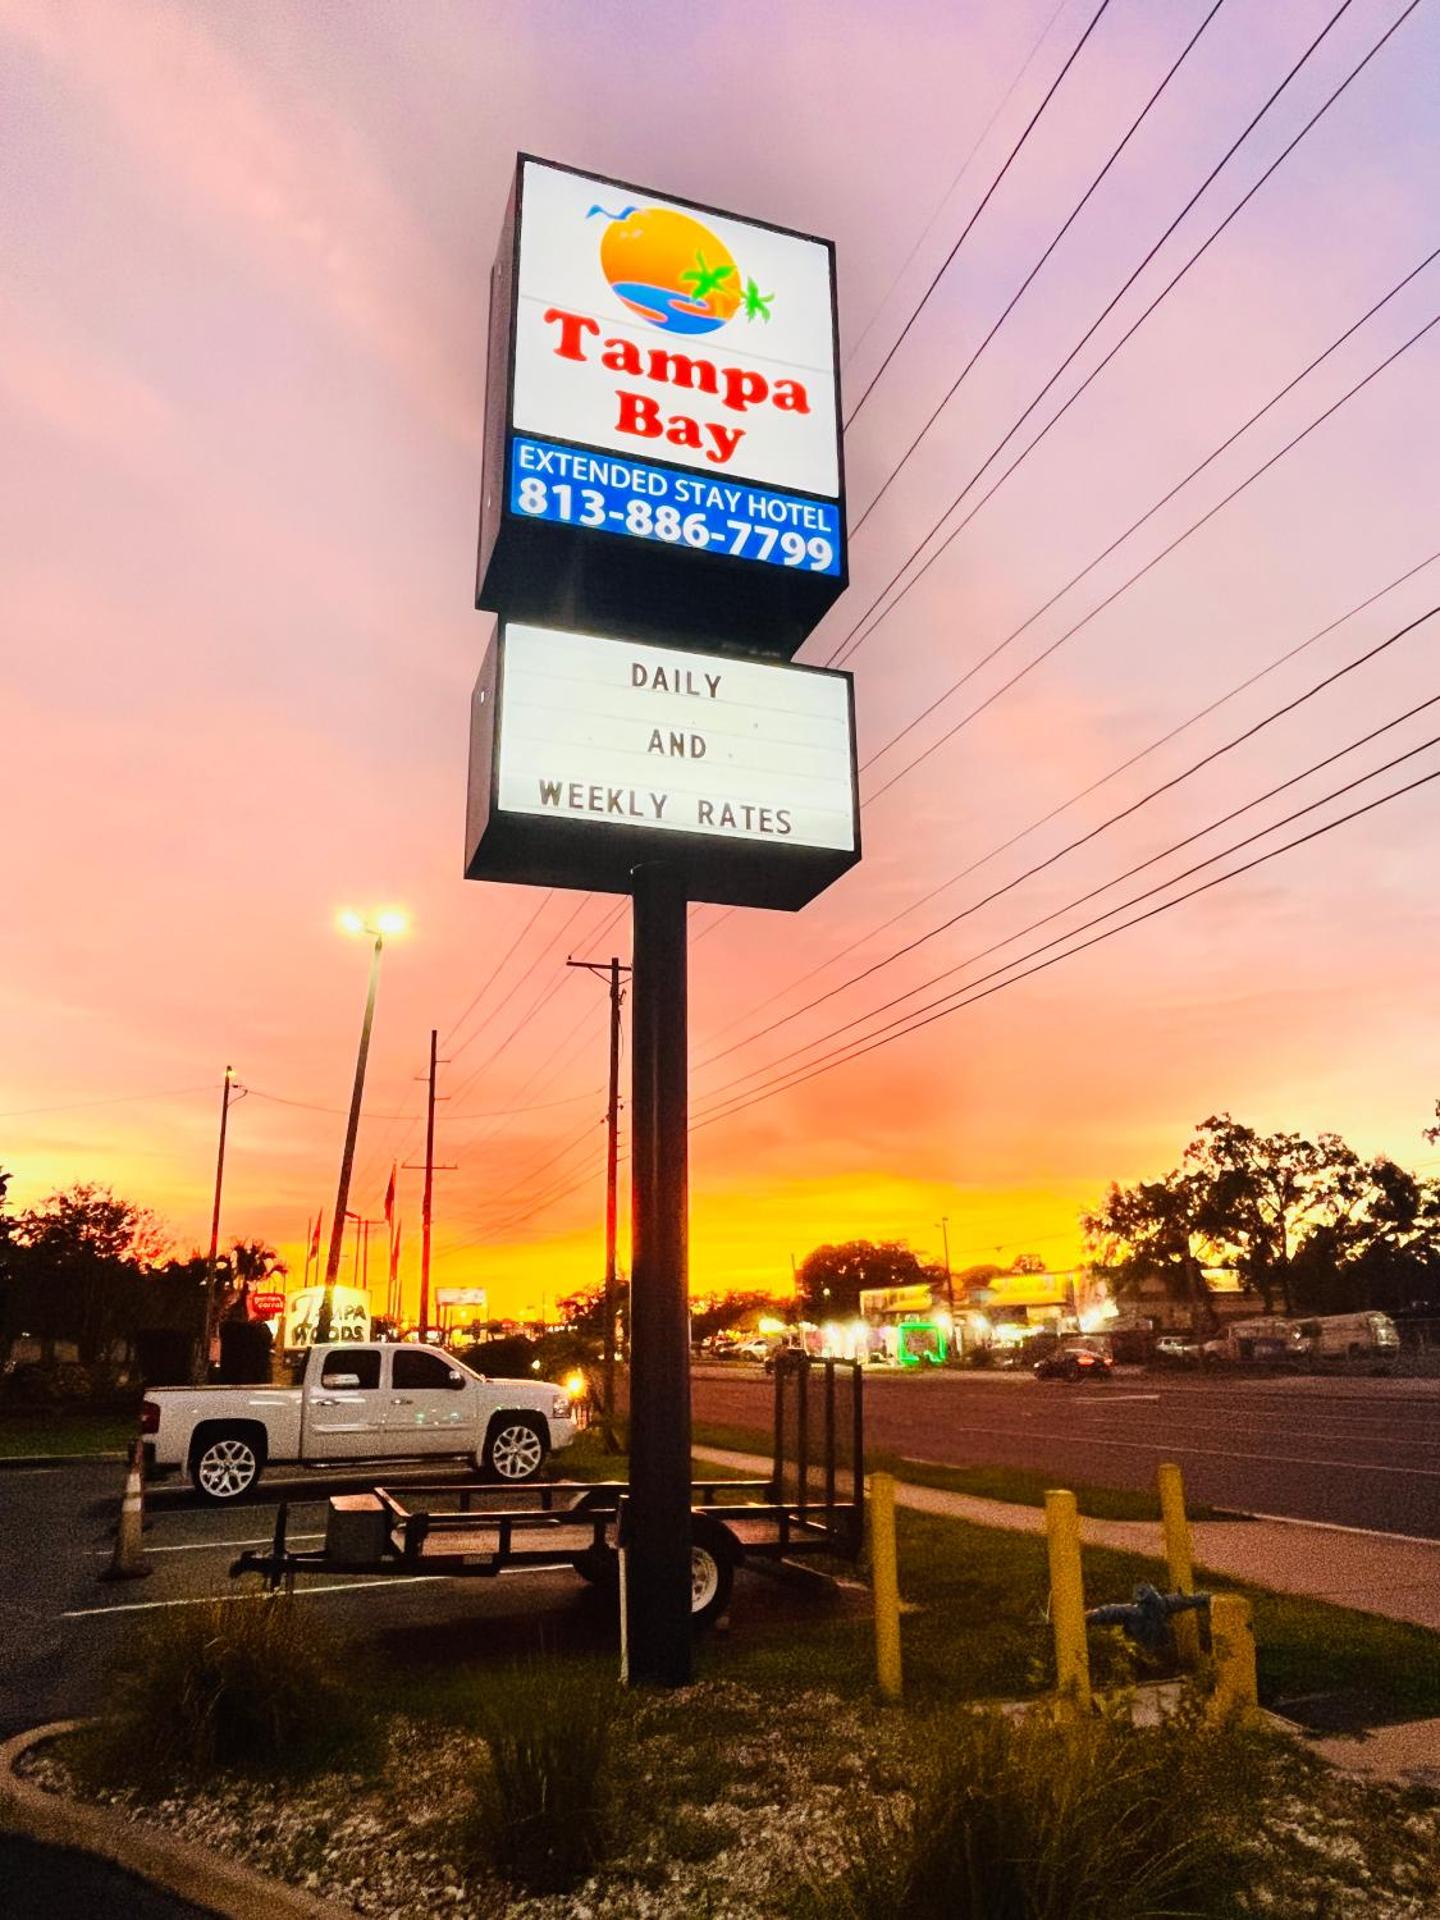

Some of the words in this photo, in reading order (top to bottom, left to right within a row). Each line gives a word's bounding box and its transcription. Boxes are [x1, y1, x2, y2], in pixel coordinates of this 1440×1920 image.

[543, 308, 811, 414] Tampa
[613, 389, 746, 463] Bay
[518, 477, 833, 571] 813-886-7799
[519, 445, 668, 496] EXTENDED
[675, 479, 742, 513] STAY
[748, 494, 832, 532] HOTEL
[631, 662, 722, 698] DAILY
[648, 729, 707, 759] AND
[538, 779, 668, 819] WEEKLY
[698, 800, 792, 835] RATES
